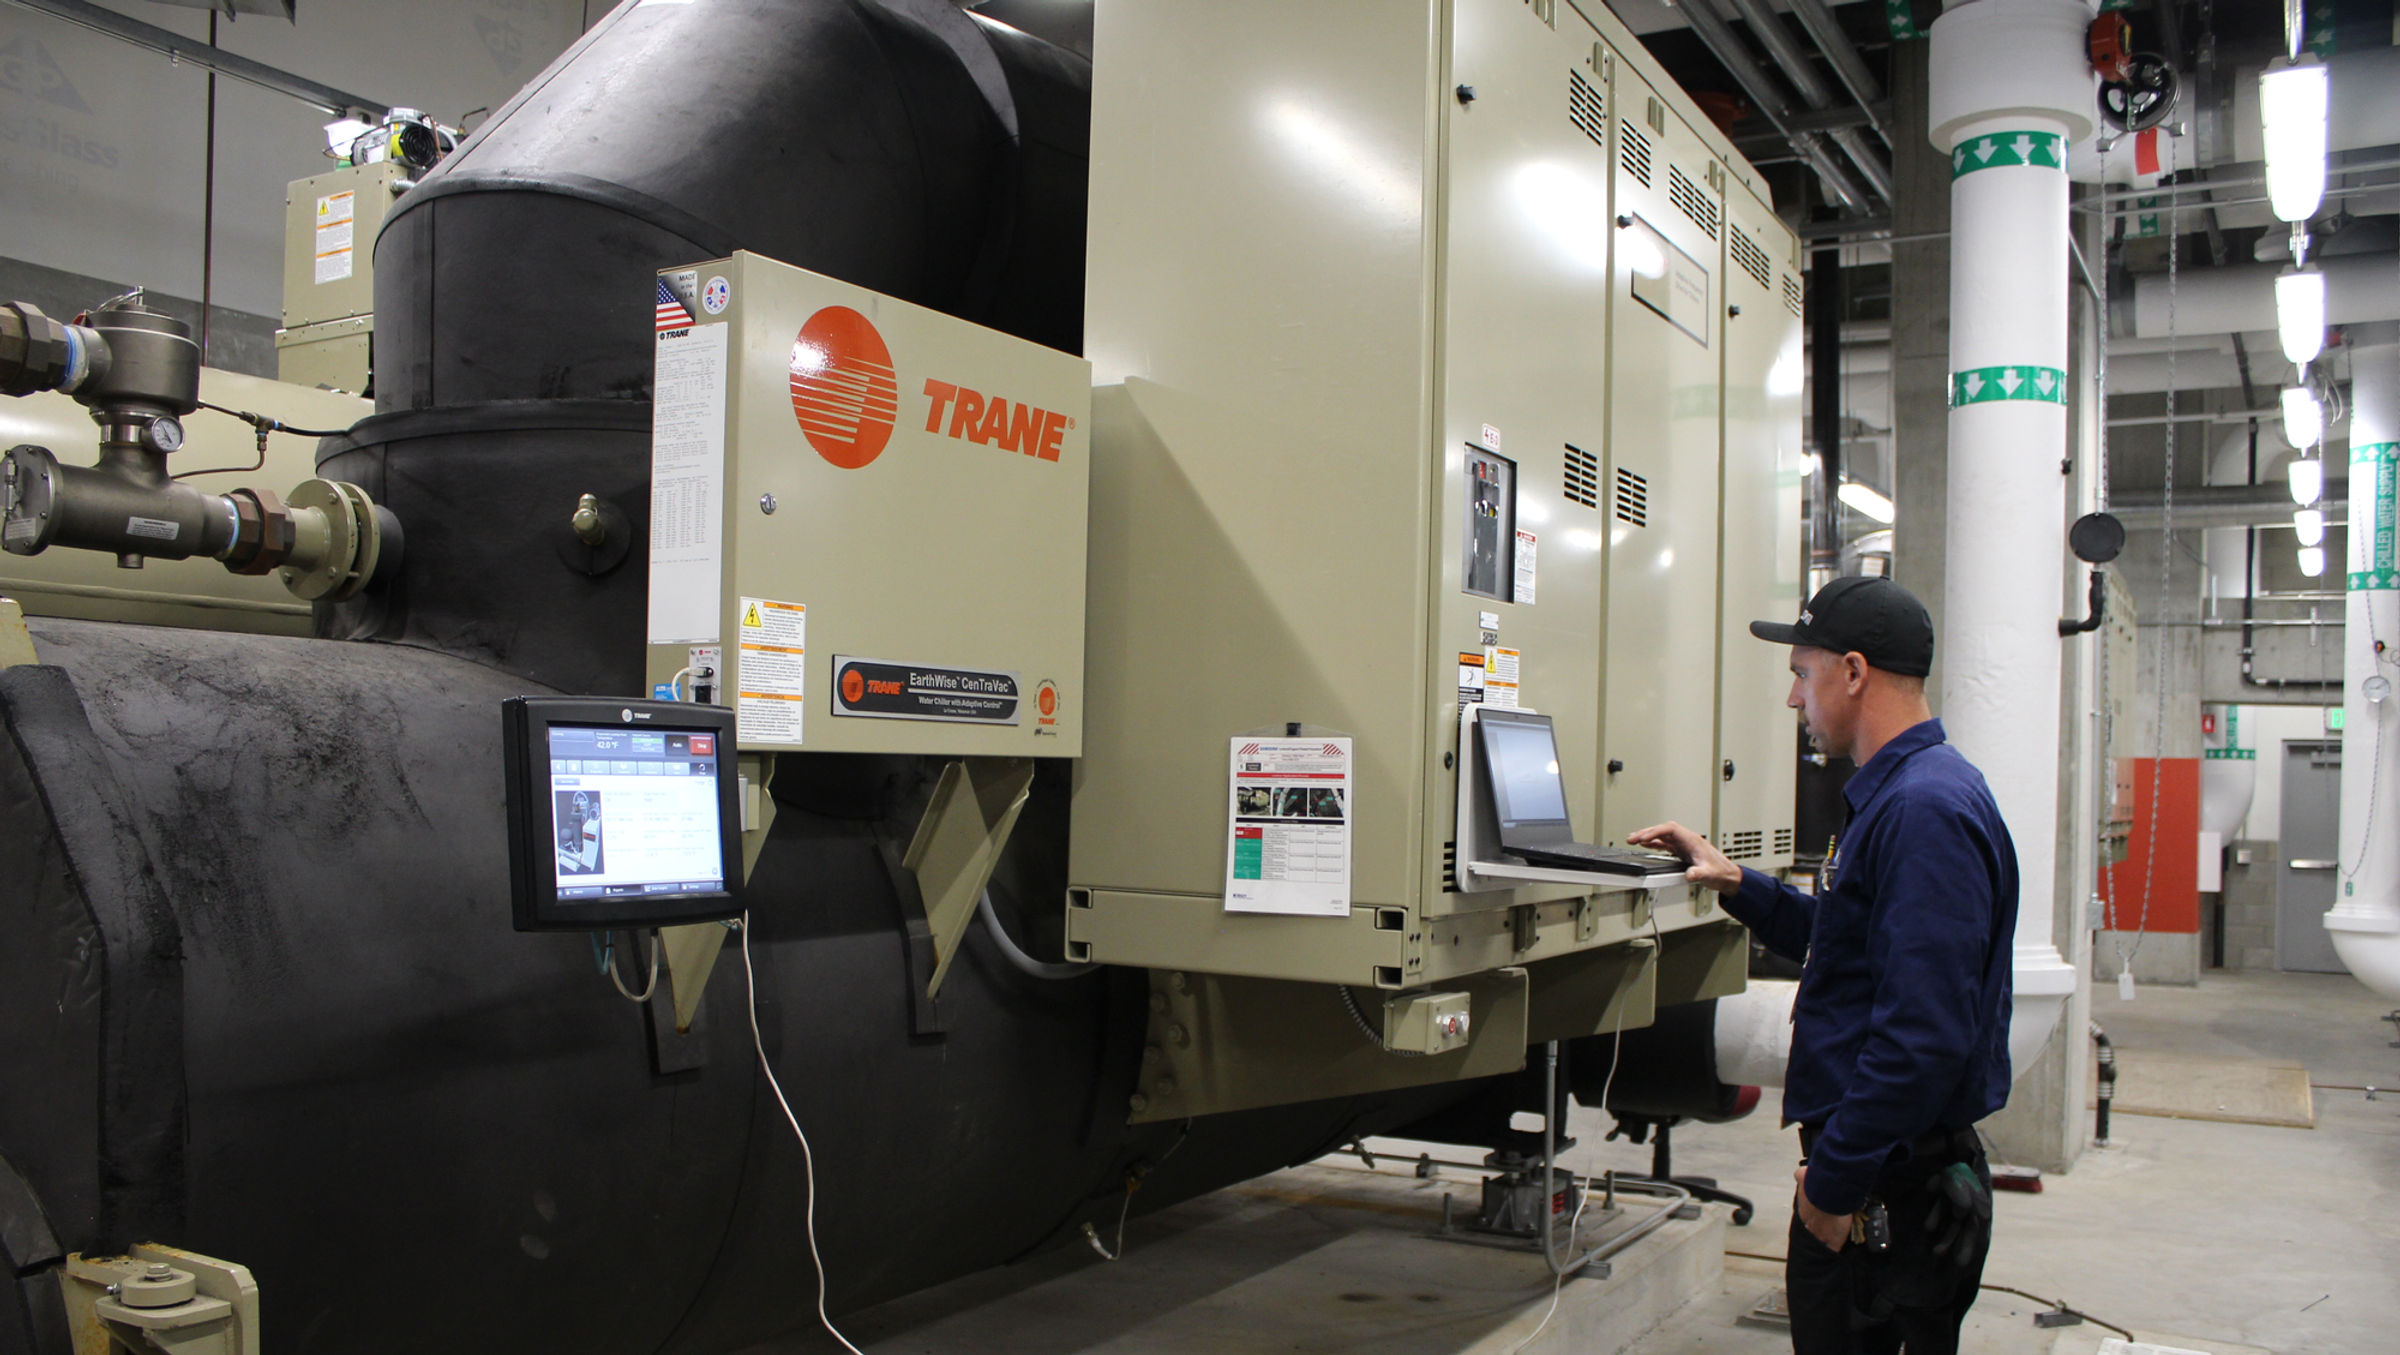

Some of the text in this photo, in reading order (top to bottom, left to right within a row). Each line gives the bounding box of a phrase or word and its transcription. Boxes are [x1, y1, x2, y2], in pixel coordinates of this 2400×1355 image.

[666, 329, 689, 339] TRANE
[2377, 463, 2394, 568] CHILLED WATER SUPPLY
[918, 696, 933, 705] Water
[934, 697, 951, 706] Chiller
[962, 699, 982, 709] Adaptive
